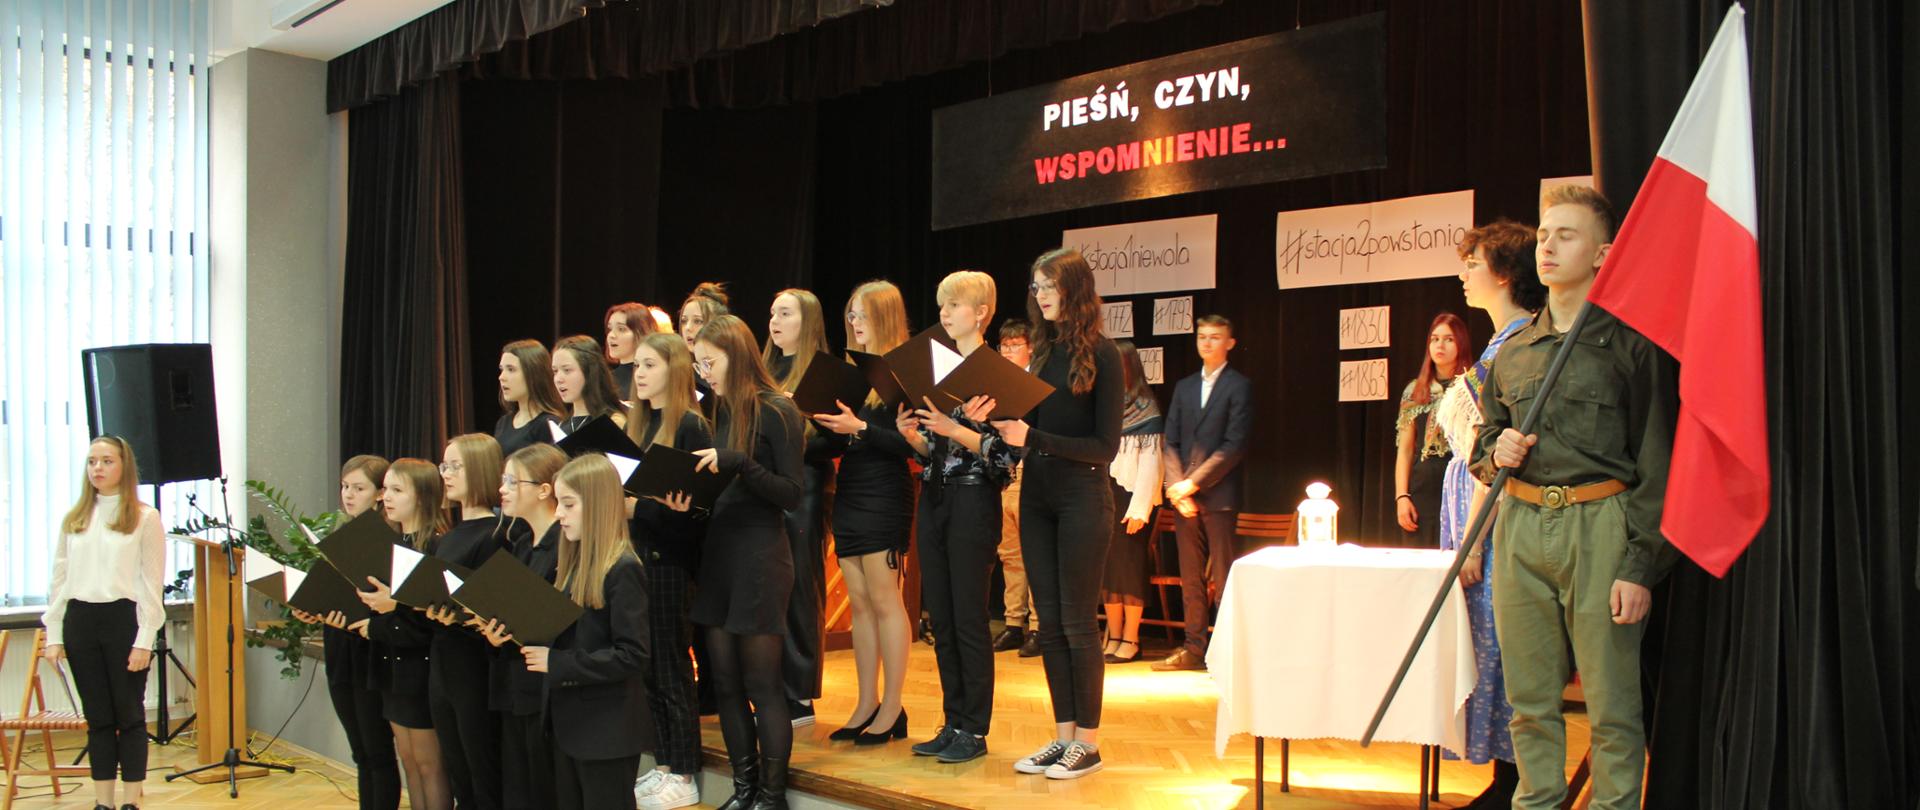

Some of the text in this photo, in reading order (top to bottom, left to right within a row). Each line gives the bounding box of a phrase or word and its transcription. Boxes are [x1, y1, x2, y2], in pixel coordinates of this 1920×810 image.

[1043, 66, 1251, 131] PIEŚŃ, CZYN,
[1034, 122, 1287, 185] WSPOMNIENIE...
[1103, 303, 1132, 333] 1772
[1154, 298, 1193, 332] #1793
[1340, 308, 1387, 345] #1830
[1341, 361, 1386, 398] #1863
